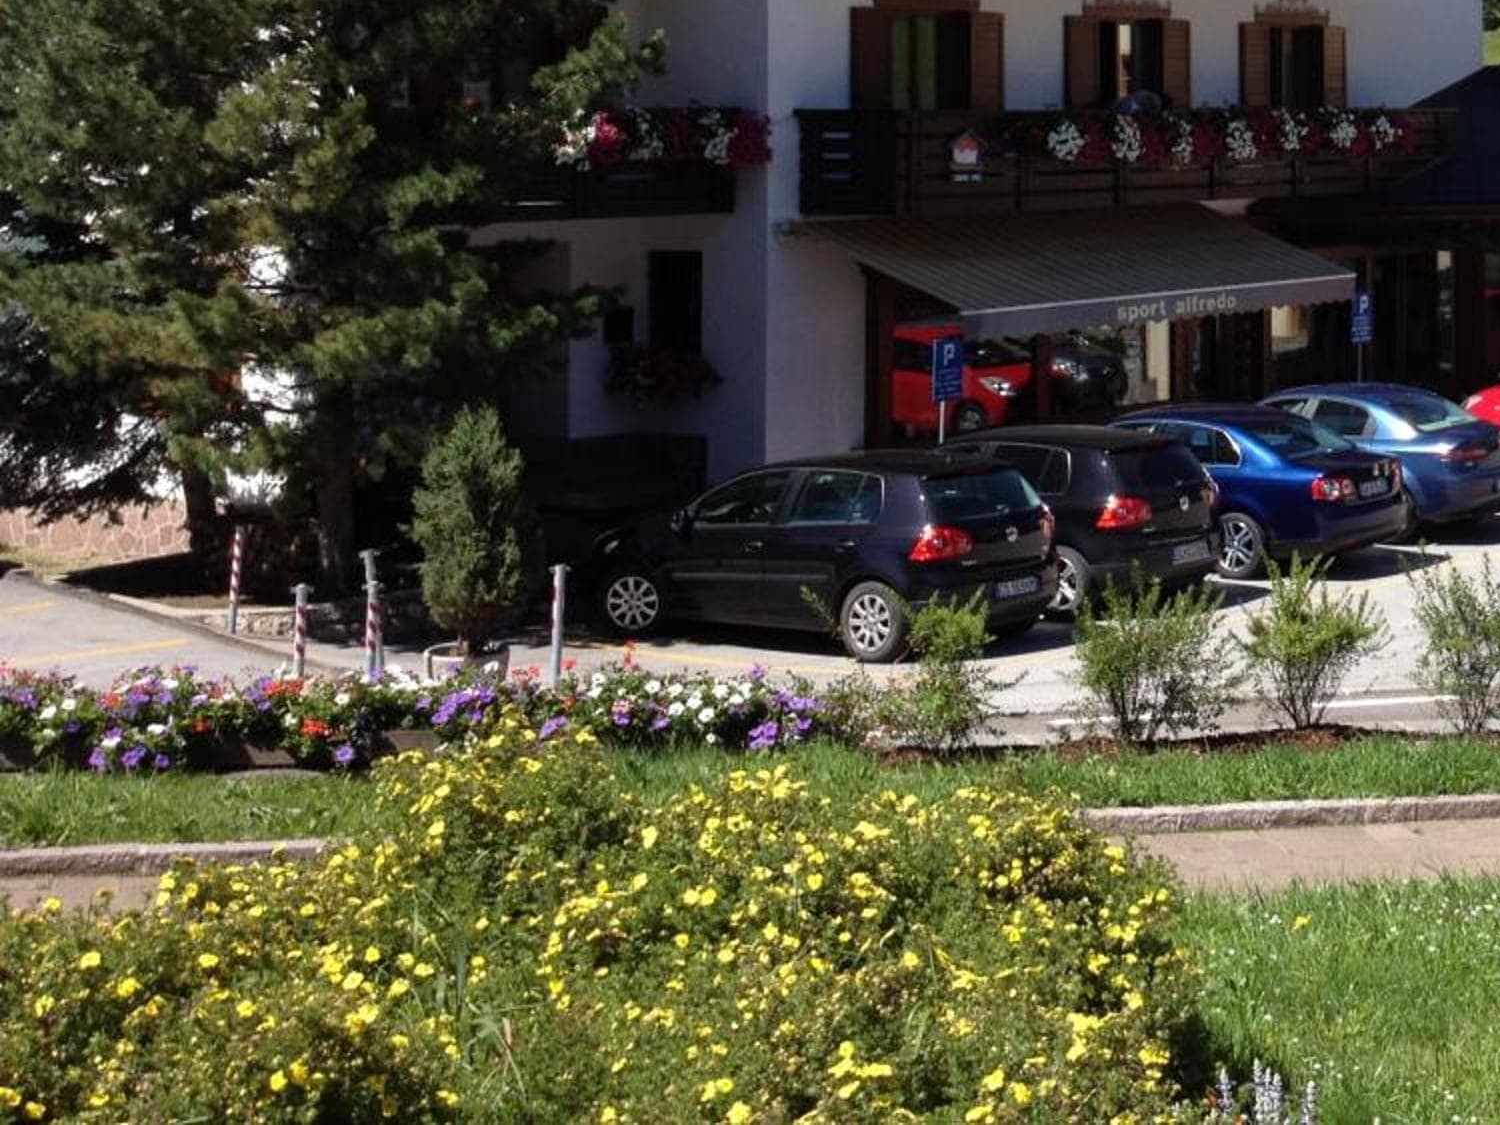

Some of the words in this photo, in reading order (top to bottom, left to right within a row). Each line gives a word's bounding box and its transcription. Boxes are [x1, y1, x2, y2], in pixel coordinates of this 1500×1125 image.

[1117, 299, 1167, 322] sport
[1176, 291, 1237, 314] alfredo
[1360, 294, 1369, 313] P
[943, 343, 955, 366] P
